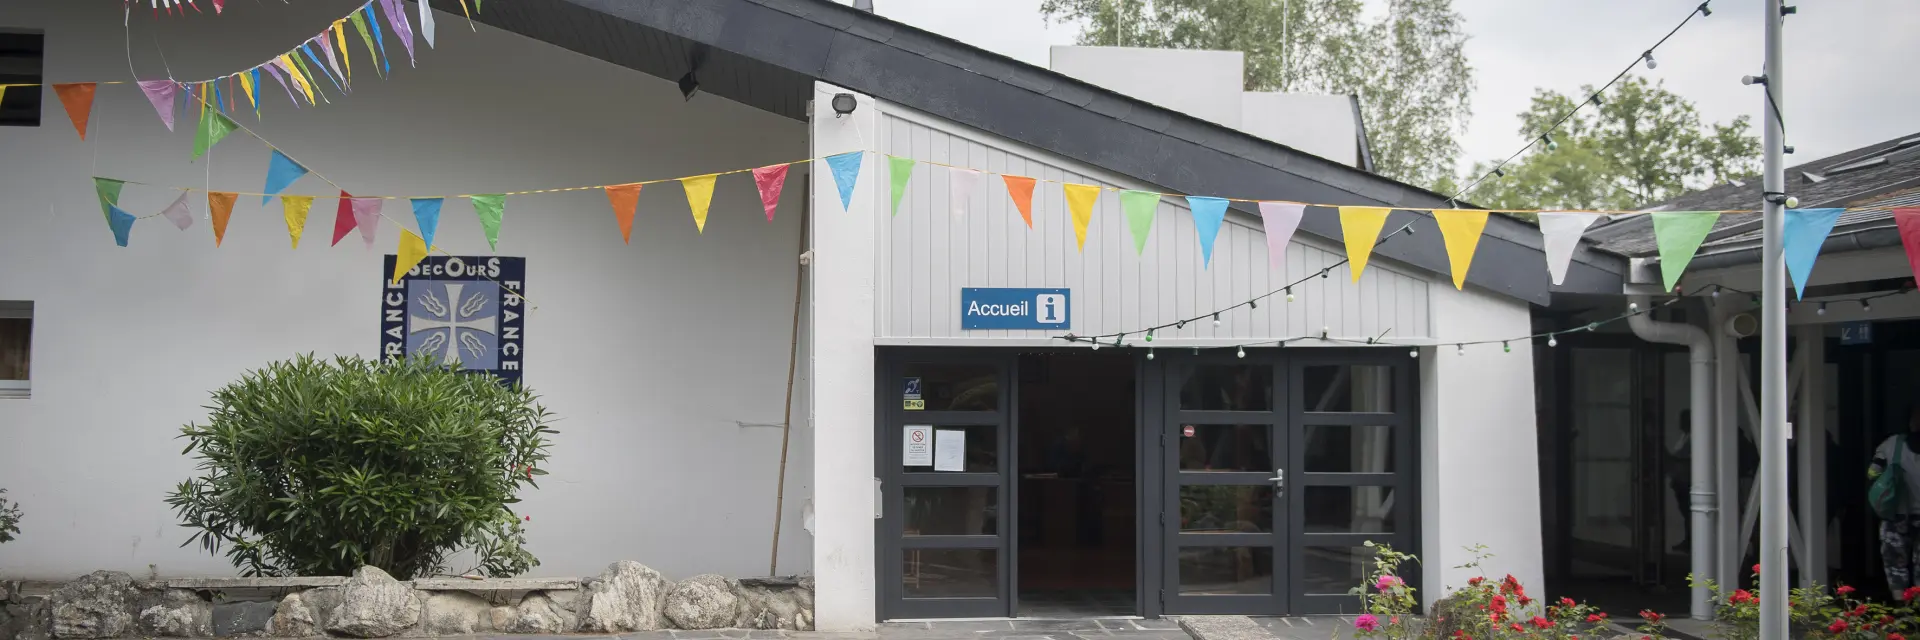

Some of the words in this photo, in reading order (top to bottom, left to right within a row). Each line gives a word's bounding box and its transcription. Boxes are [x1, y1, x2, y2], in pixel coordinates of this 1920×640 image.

[385, 278, 404, 366] RANCE
[502, 280, 521, 371] FRANCE
[967, 300, 1029, 317] Accueil
